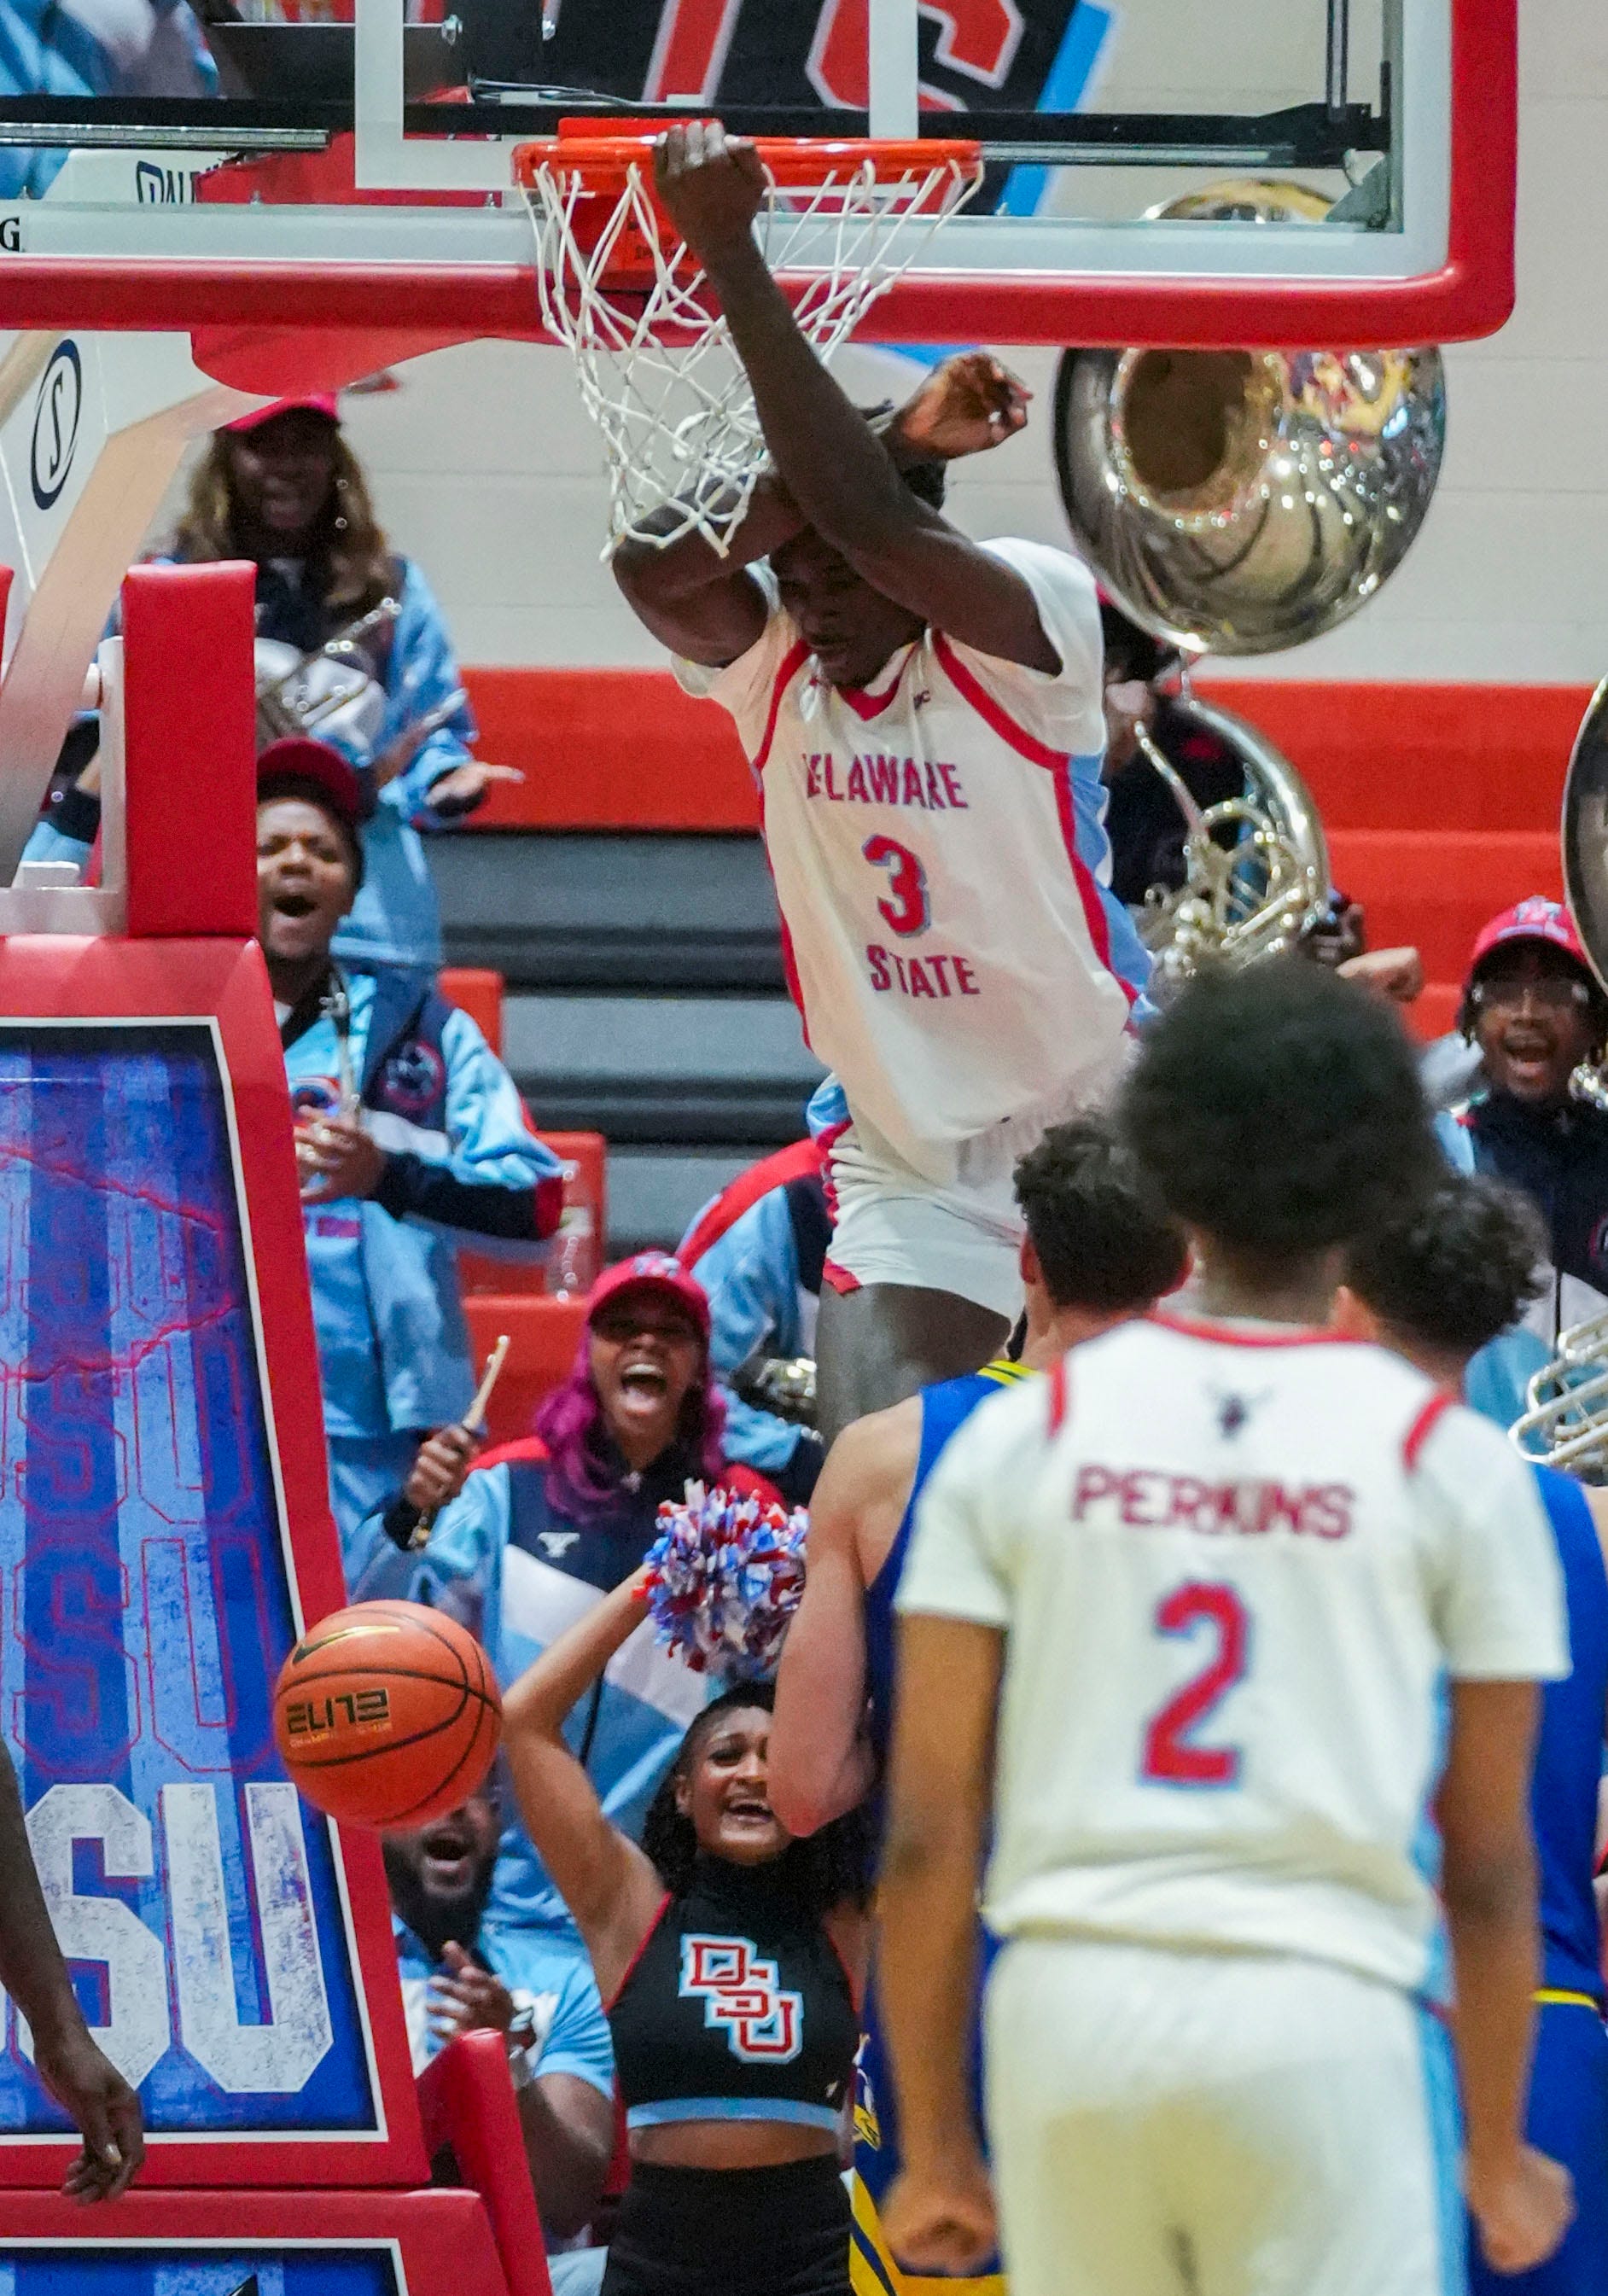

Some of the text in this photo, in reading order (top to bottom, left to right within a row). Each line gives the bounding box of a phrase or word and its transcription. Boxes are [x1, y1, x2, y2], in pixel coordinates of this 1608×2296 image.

[860, 833, 932, 939] 3
[865, 943, 982, 999] STATE
[286, 1688, 390, 1735] ELITE
[1137, 1576, 1248, 1791] 2
[0, 1781, 335, 2094] SU
[679, 1932, 805, 2065] DSU
